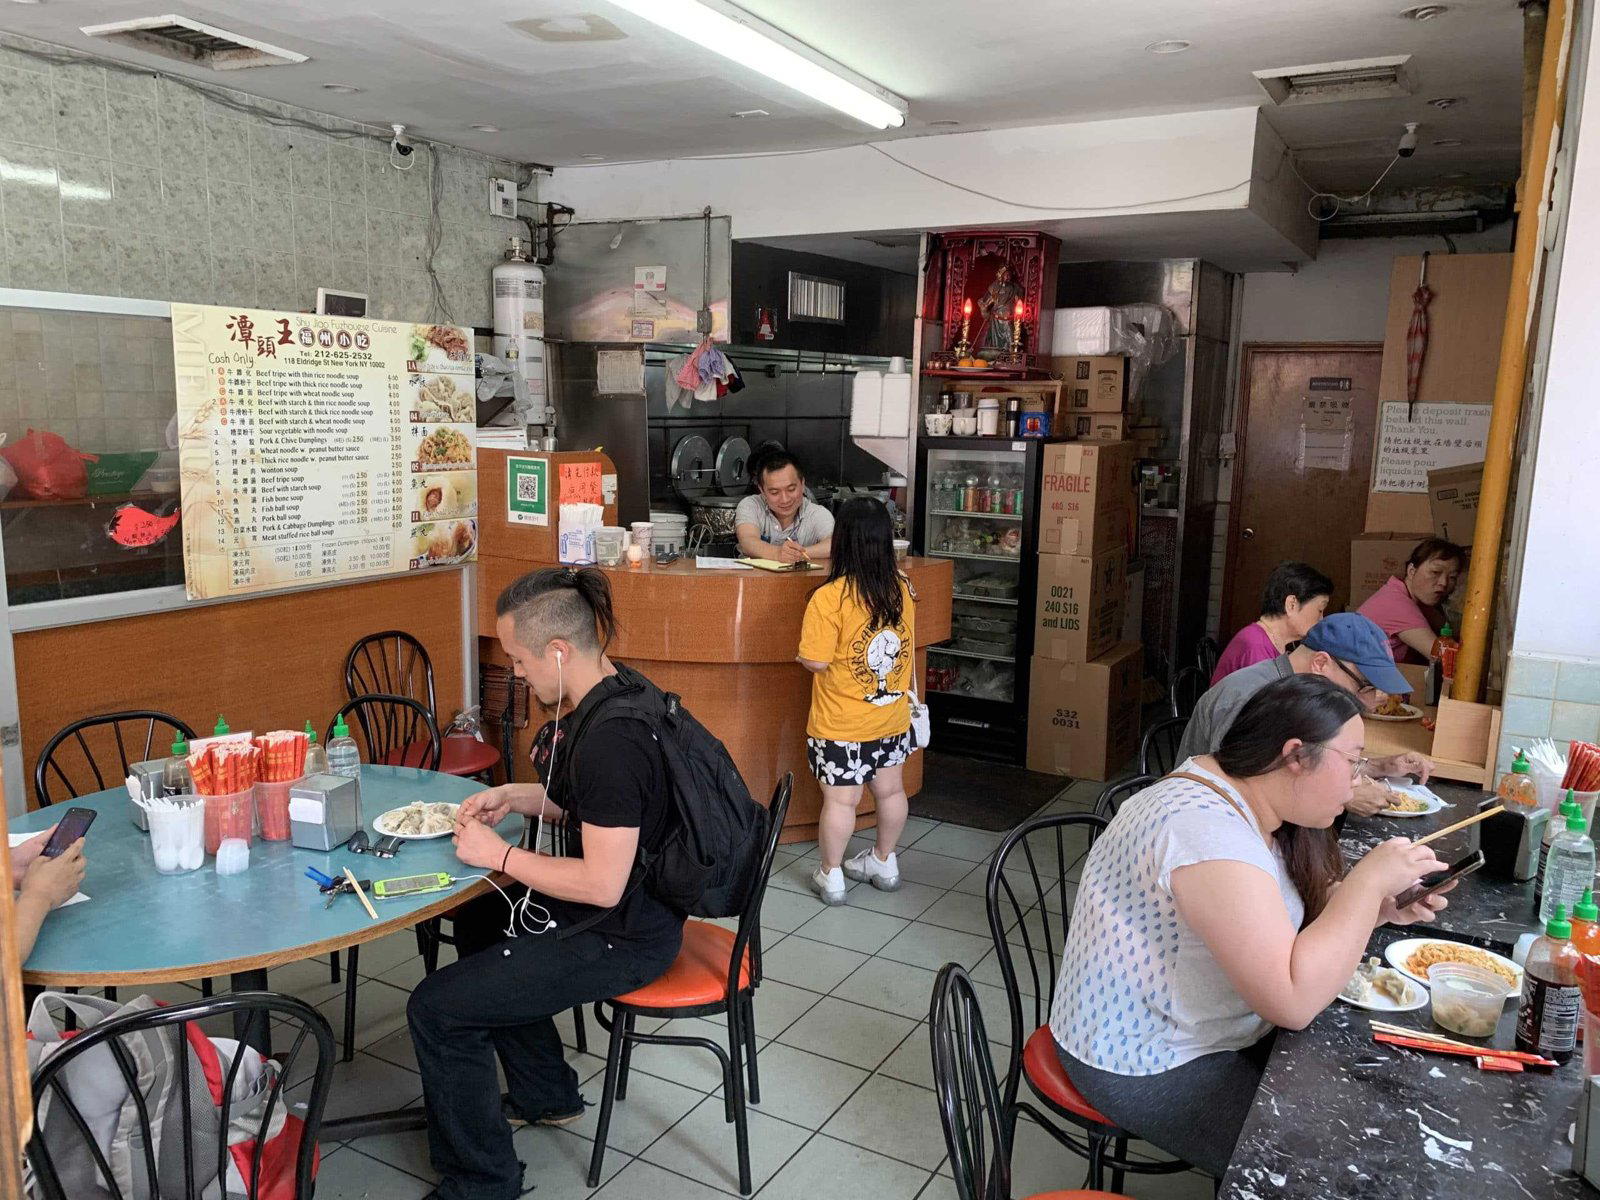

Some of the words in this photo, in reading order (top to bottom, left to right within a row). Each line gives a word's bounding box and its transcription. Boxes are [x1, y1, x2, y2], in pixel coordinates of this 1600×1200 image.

[372, 322, 399, 334] Cuisine
[299, 328, 370, 349] 福州小吃
[208, 352, 230, 364] Cash
[233, 352, 254, 368] Only
[314, 350, 372, 360] 212-625-2532
[296, 358, 321, 367] Eldridge
[272, 370, 286, 379] tripe
[273, 379, 287, 389] tripe
[273, 389, 288, 398] tripe
[1386, 405, 1418, 414] Pleae
[1422, 407, 1462, 416] deposit
[1465, 408, 1490, 416] trash
[1424, 416, 1444, 425] this
[274, 427, 302, 436] vegetable
[1384, 425, 1416, 434] Thank
[298, 436, 327, 445] Dumplings
[309, 445, 327, 455] peanut
[318, 455, 337, 464] peanut
[1381, 457, 1410, 466] Please
[1414, 460, 1437, 468] pour
[1380, 466, 1411, 476] liquids
[276, 475, 290, 485] tripe
[1044, 475, 1091, 492] FRAGILE
[290, 484, 308, 492] starch
[308, 485, 322, 493] soup
[290, 495, 304, 503] soup
[286, 505, 300, 513] soup
[1068, 502, 1079, 512] S16
[262, 514, 275, 522] Pork
[288, 514, 301, 522] soup
[262, 523, 275, 532] Pork
[282, 522, 306, 531] Cabbage
[307, 520, 335, 529] Dumplings
[1051, 586, 1073, 598] 0021
[1045, 600, 1060, 613] 240
[1063, 602, 1079, 614] S16
[1042, 617, 1058, 628] and
[1060, 618, 1080, 630] LIDS
[1056, 708, 1078, 719] S32
[1052, 718, 1080, 729] 0031
